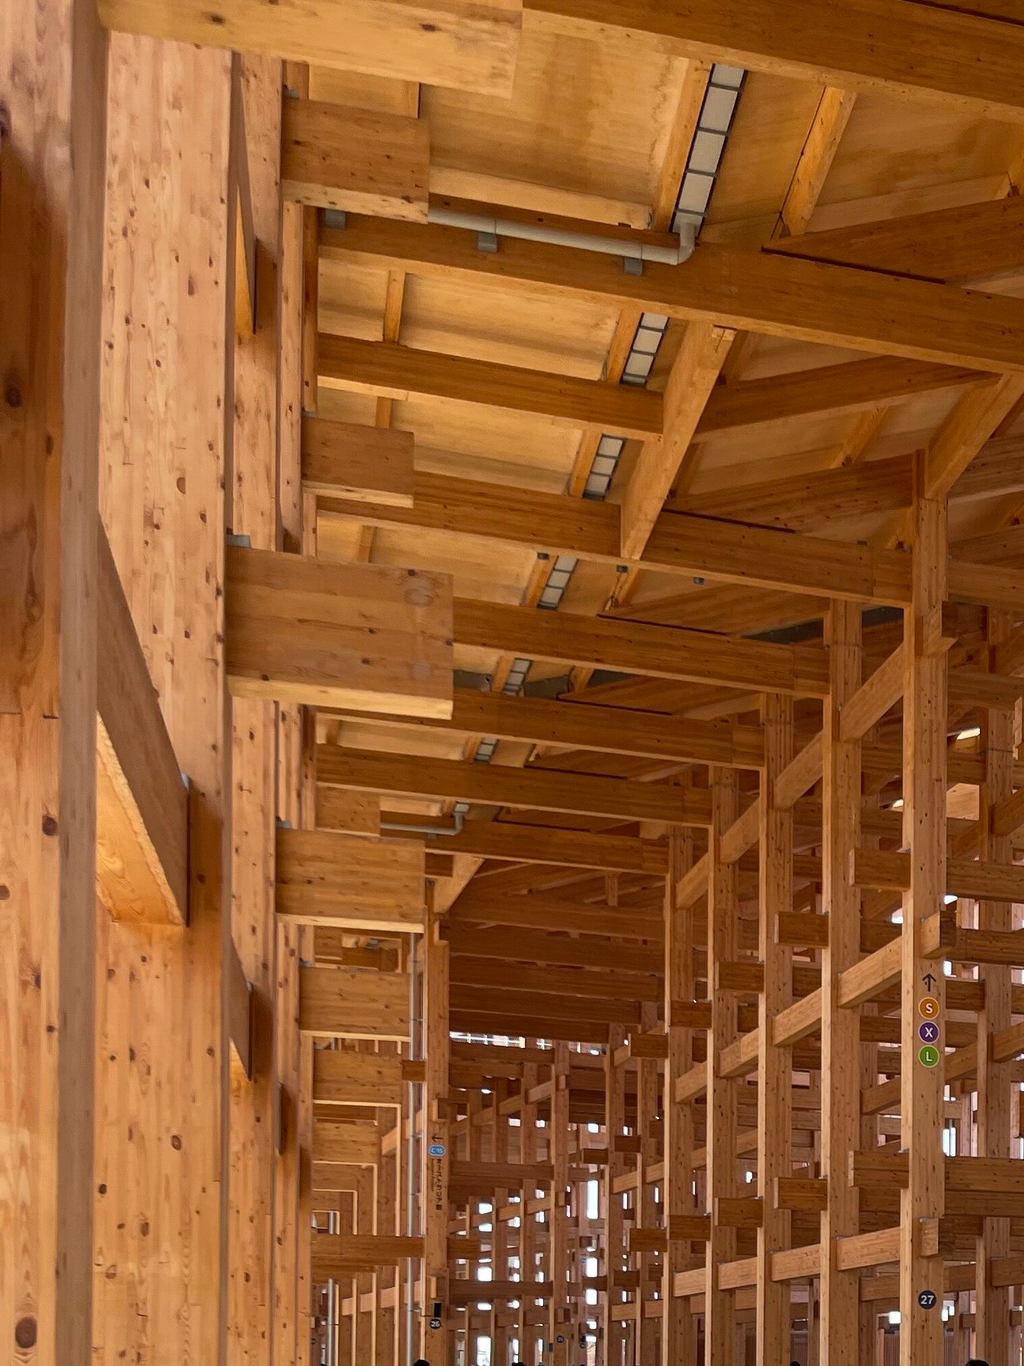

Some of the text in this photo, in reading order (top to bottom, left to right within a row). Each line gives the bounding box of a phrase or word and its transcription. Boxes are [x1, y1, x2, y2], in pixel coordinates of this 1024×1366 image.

[925, 1003, 933, 1014] S
[925, 1027, 933, 1038] X
[926, 1051, 933, 1062] L
[921, 1295, 934, 1305] 27
